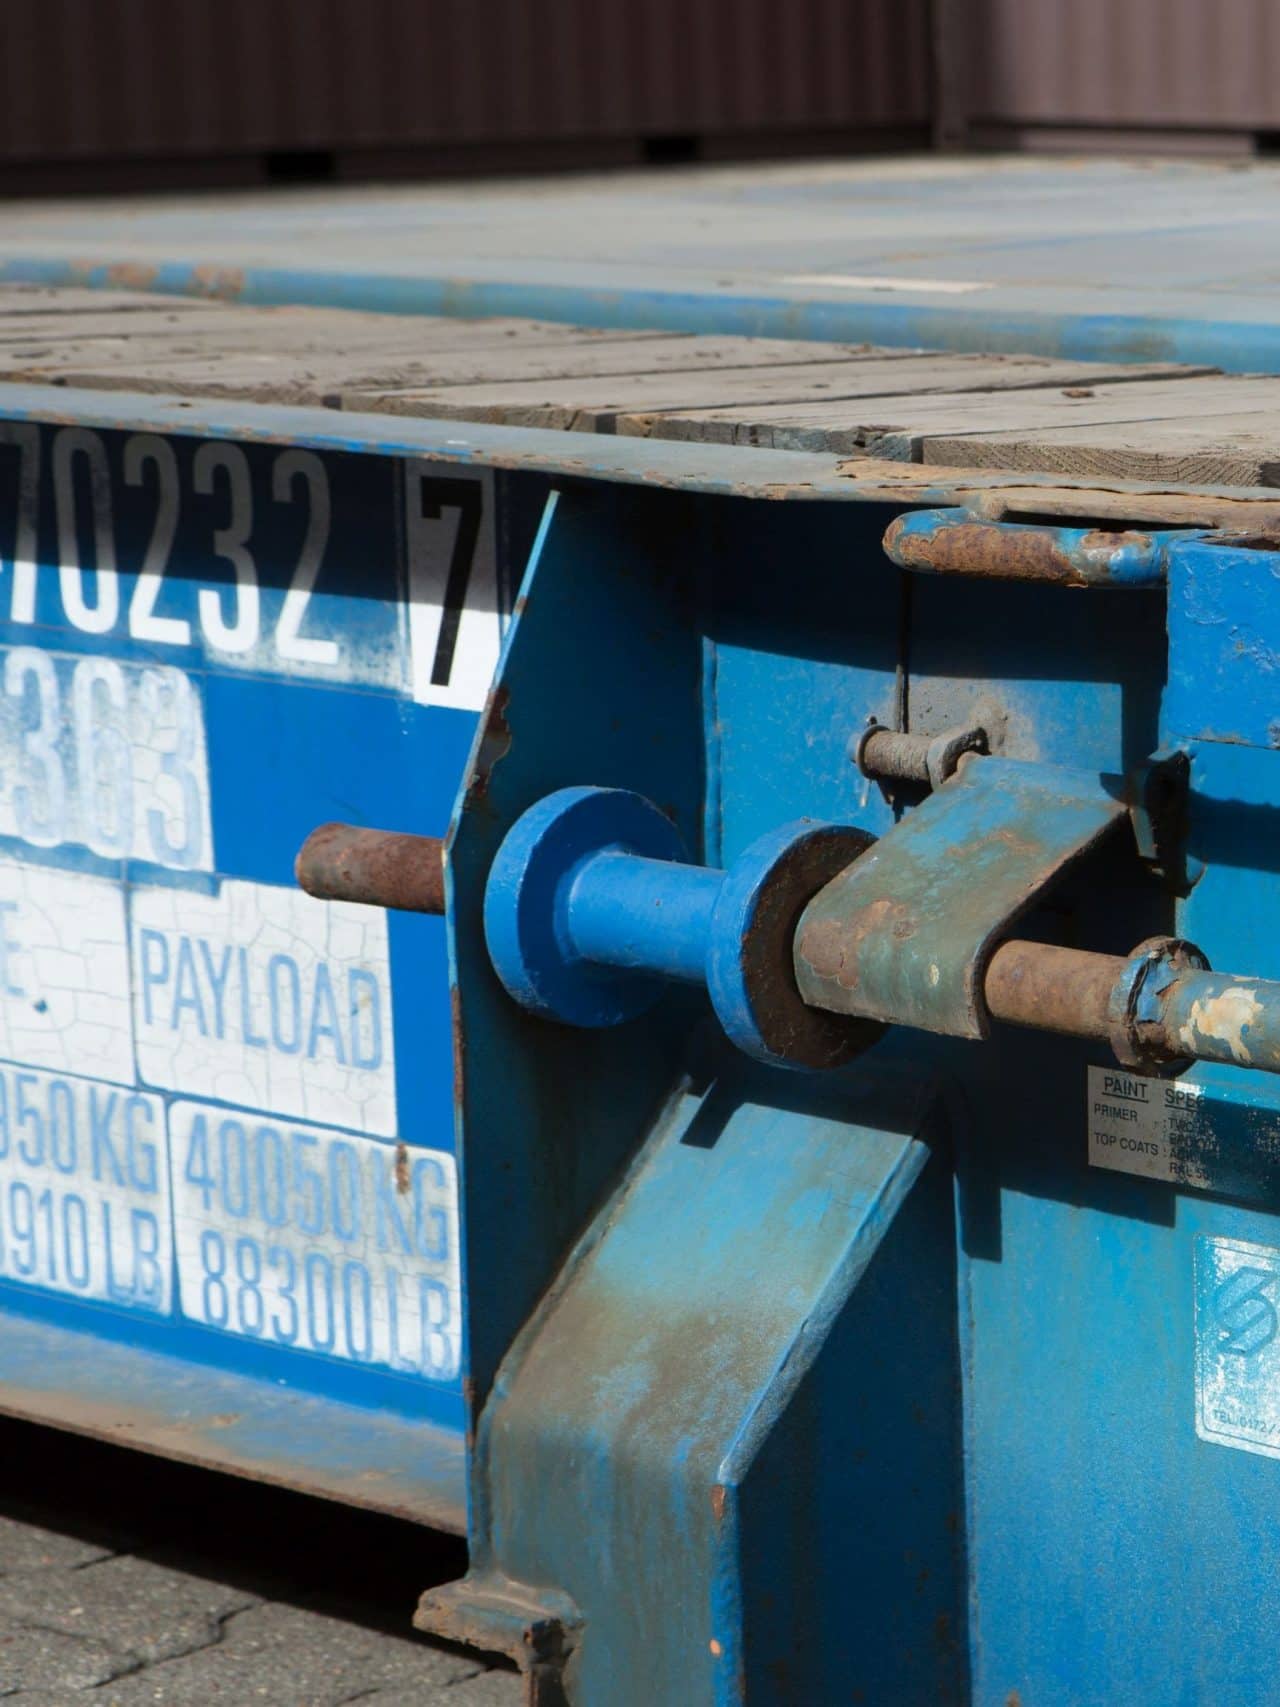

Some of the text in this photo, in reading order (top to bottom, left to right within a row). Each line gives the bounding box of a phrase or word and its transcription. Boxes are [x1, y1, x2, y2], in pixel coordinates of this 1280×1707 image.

[420, 475, 485, 688] 7
[140, 928, 384, 1071] PAYLOAD
[1103, 1076, 1149, 1099] PAINT
[1094, 1103, 1138, 1121] PRIMER
[1093, 1131, 1117, 1146] TOP
[1119, 1137, 1158, 1156] COATS
